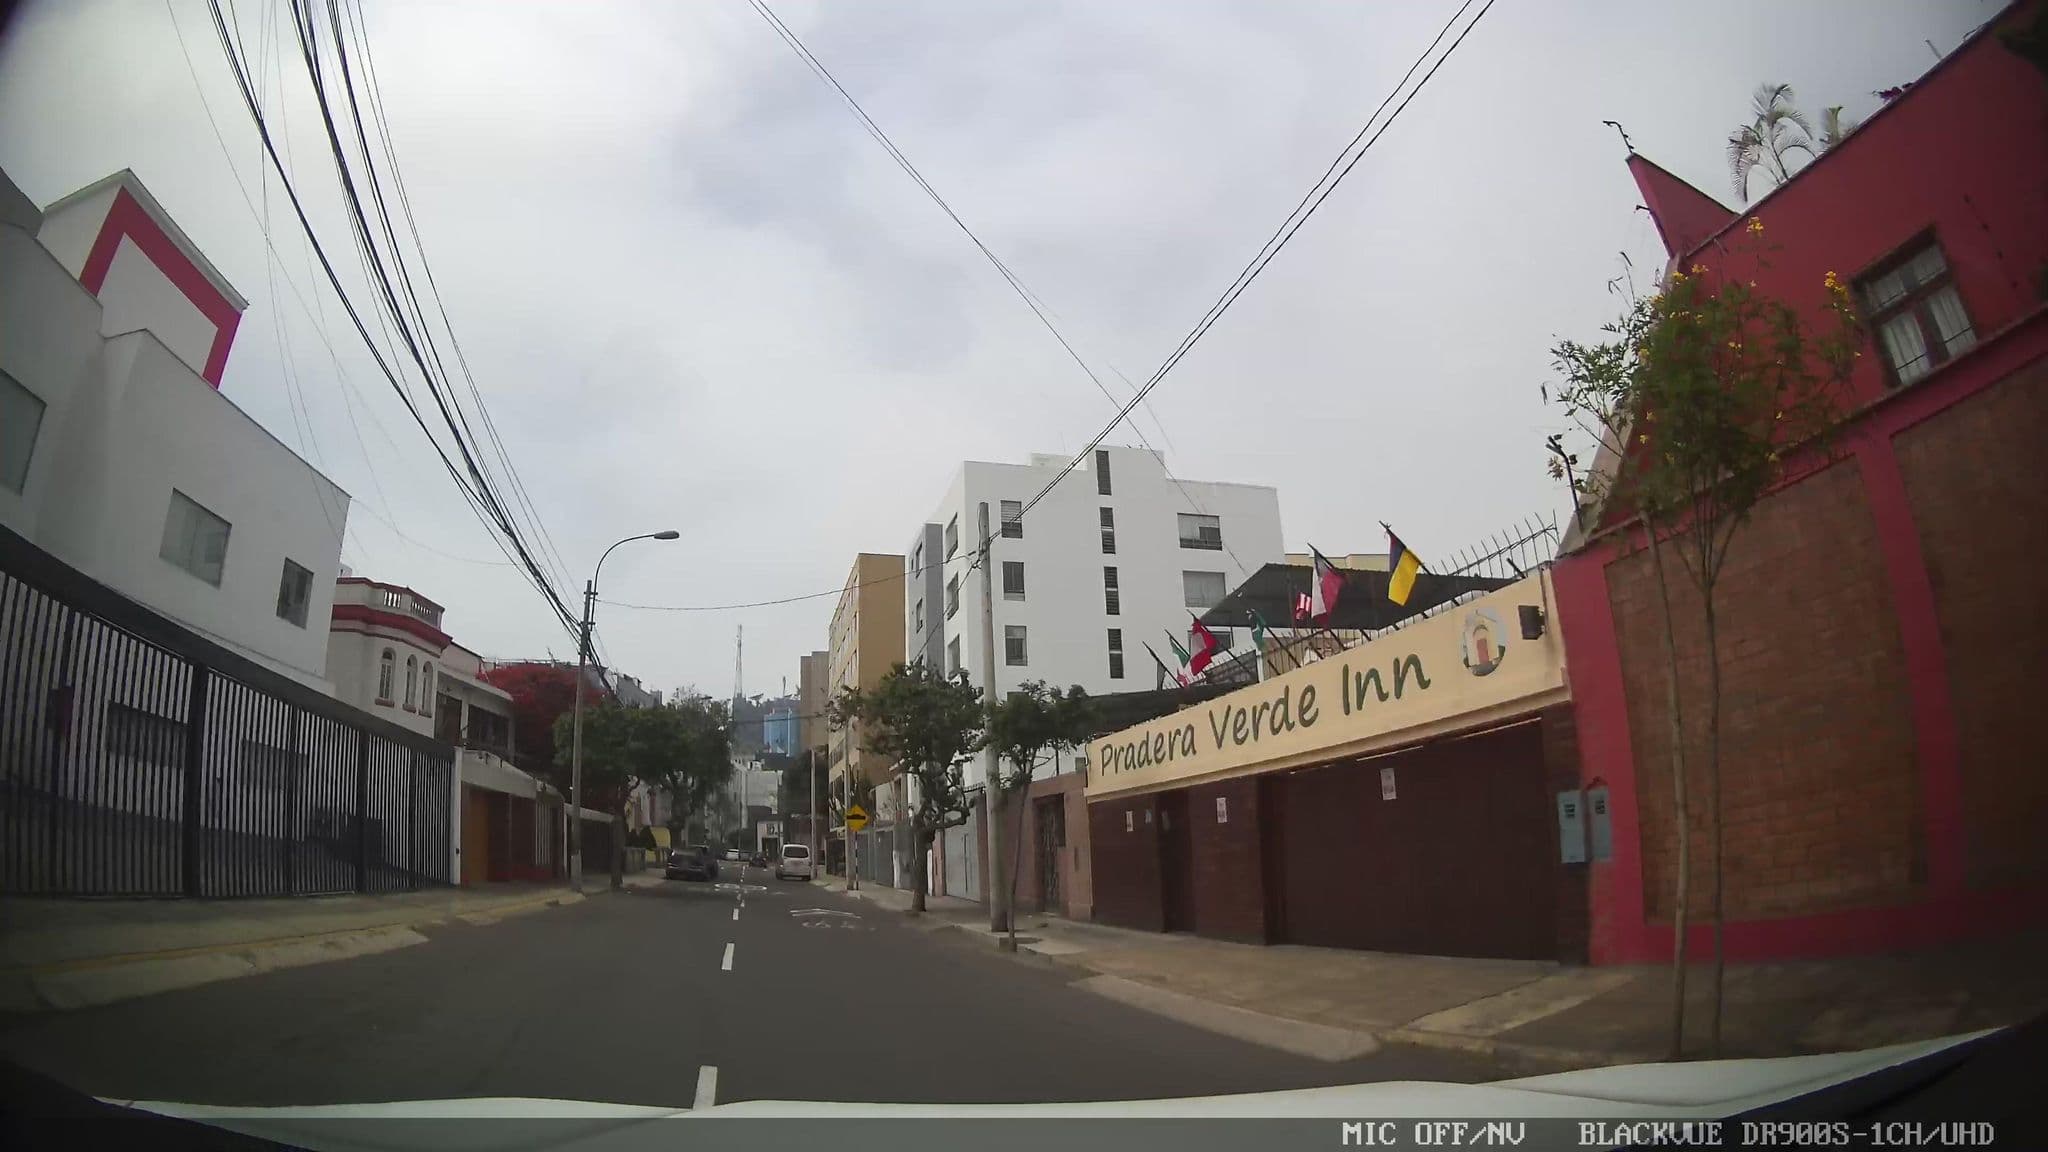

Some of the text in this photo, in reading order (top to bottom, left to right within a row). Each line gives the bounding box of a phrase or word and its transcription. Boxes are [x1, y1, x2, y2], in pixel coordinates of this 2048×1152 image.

[1101, 653, 1432, 777] Pradera Verde Inn
